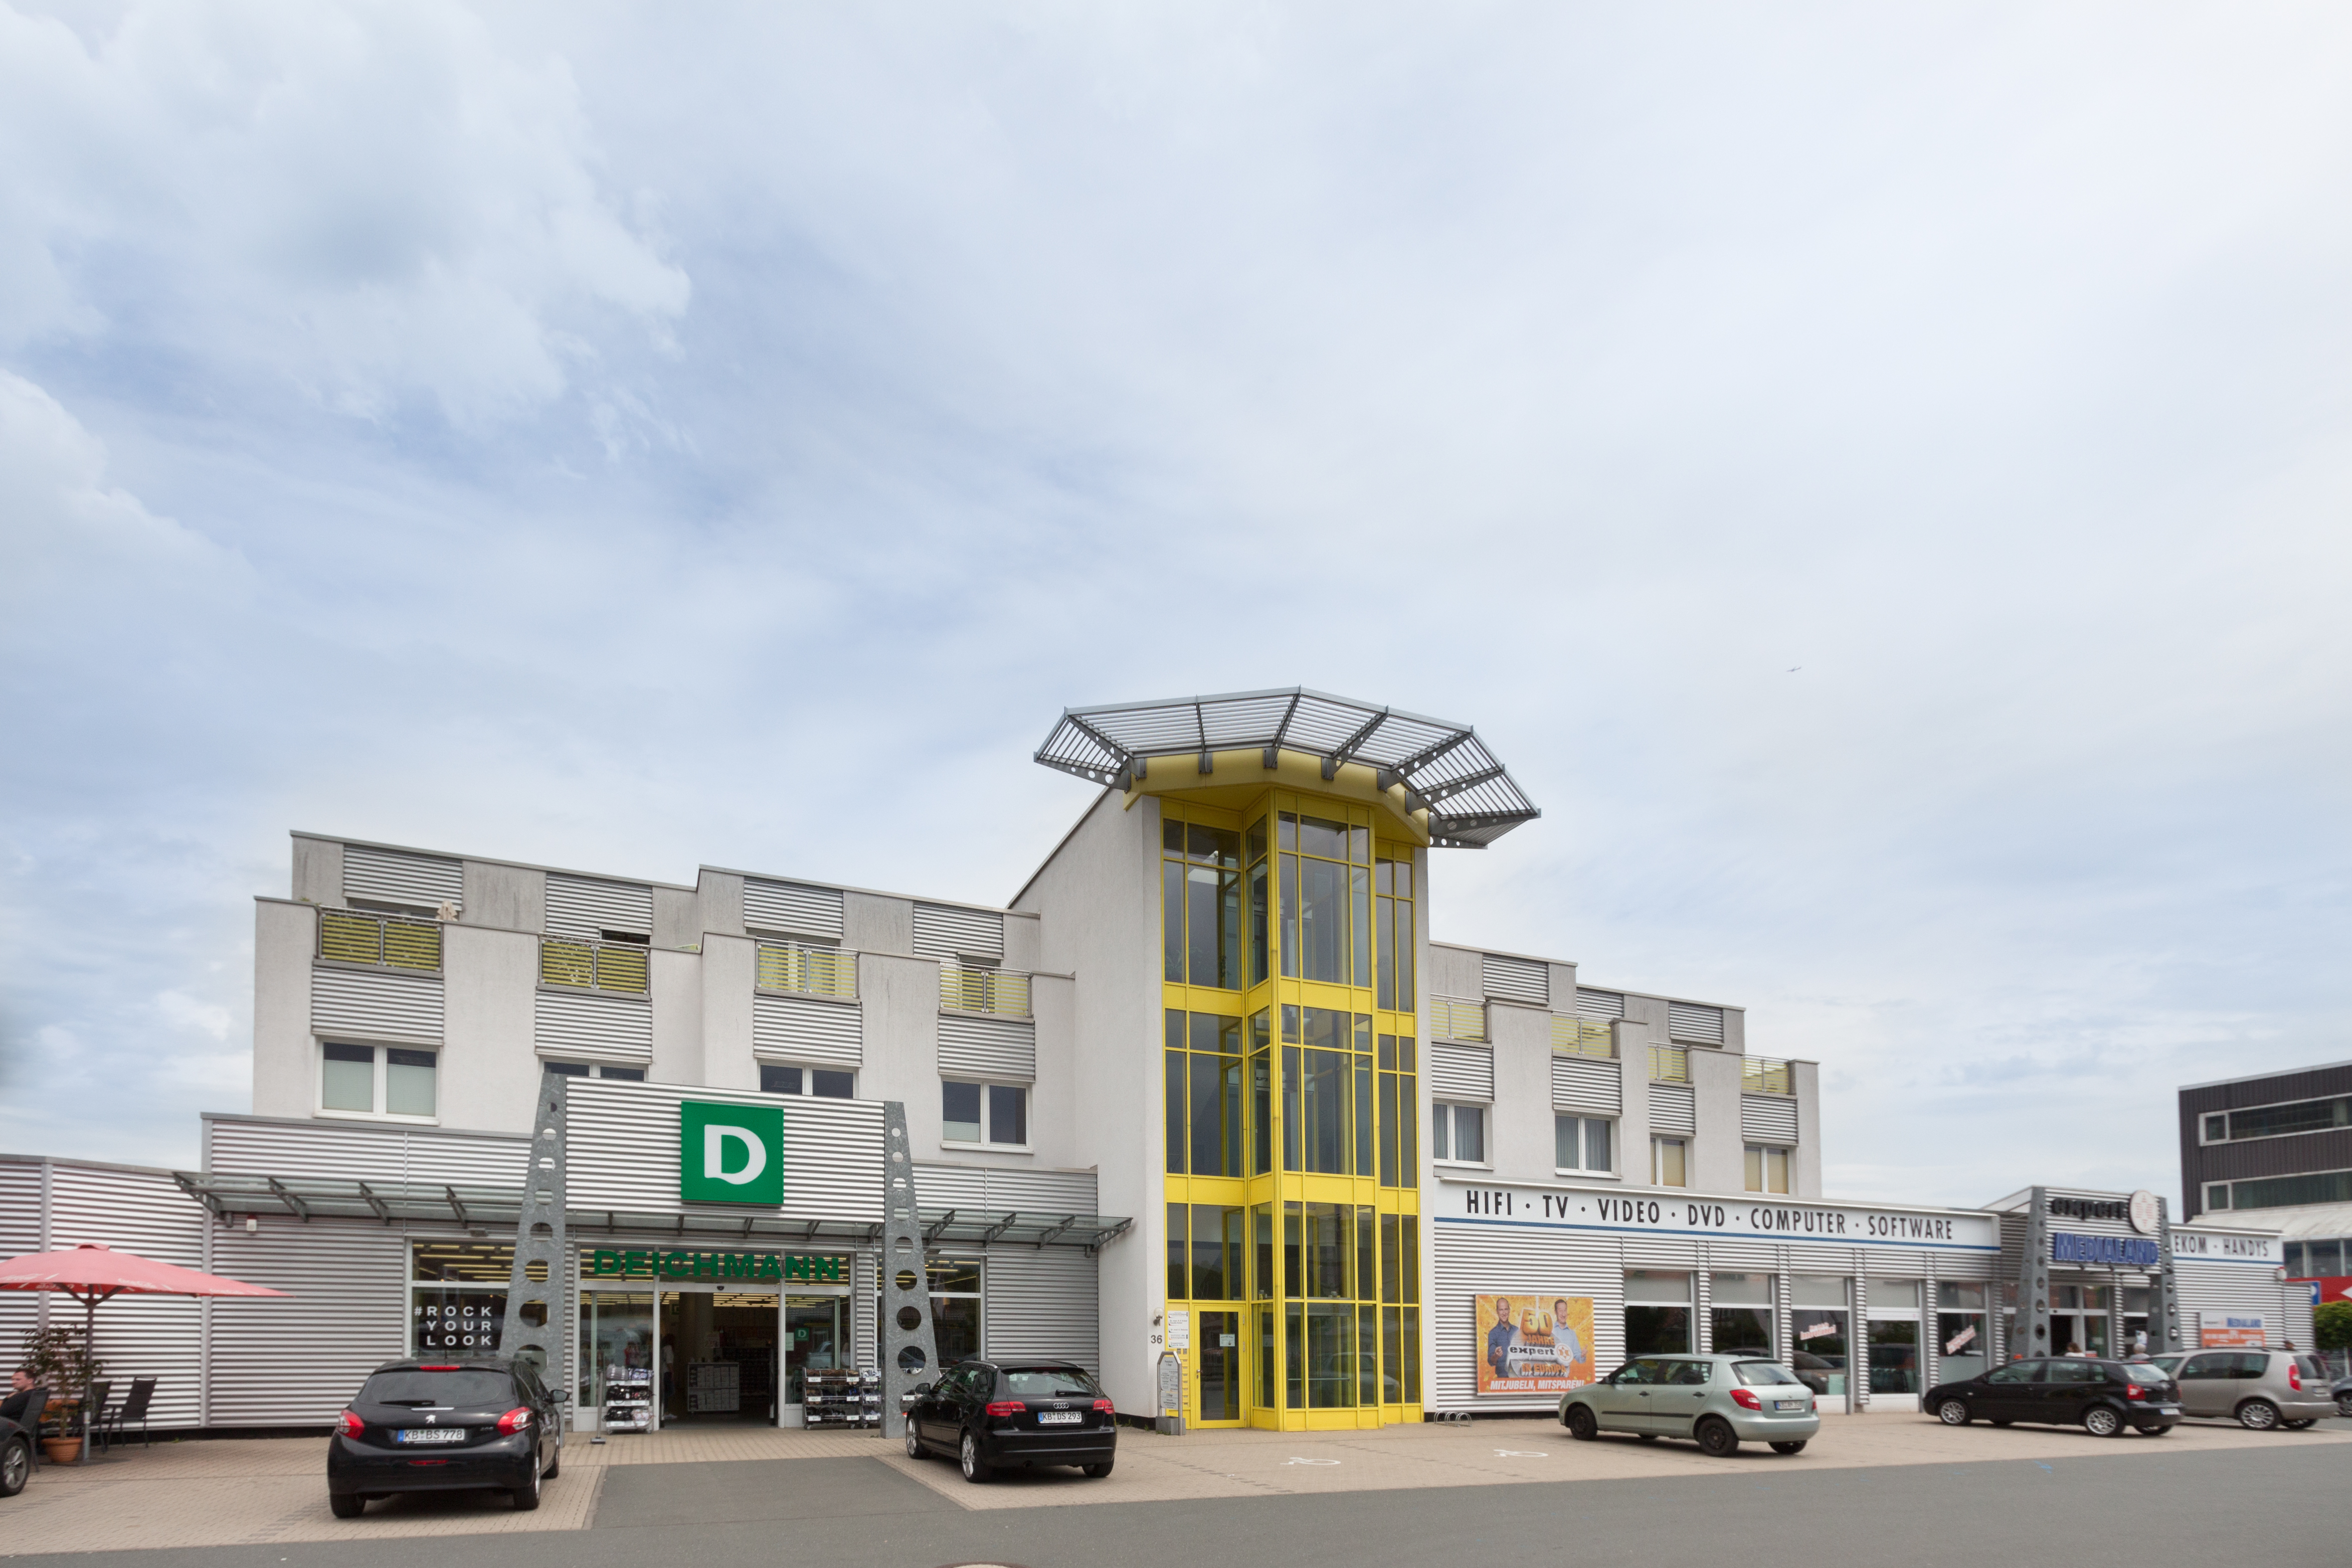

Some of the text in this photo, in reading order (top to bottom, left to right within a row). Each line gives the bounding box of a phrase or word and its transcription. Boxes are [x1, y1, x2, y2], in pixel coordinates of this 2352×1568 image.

[704, 1124, 766, 1185] D
[1466, 1190, 1953, 1240] HIFI TV VIDEO DVD COMPUTER SOFTWARE
[2051, 1198, 2129, 1220] expert
[2054, 1231, 2159, 1265] MEDIALAND
[2172, 1235, 2269, 1257] EKOM HANDYS
[593, 1250, 839, 1280] DEICHMANN
[414, 1305, 492, 1317] #ROCK
[426, 1321, 492, 1331] YOUR
[1520, 1309, 1554, 1337] 50
[426, 1335, 492, 1346] LOOK
[1151, 1335, 1163, 1344] 36
[1526, 1334, 1556, 1347] JAHRE
[1510, 1346, 1555, 1356] expert
[1521, 1363, 1567, 1375] IN EUROPA
[1490, 1380, 1585, 1391] MITJUBELN, MITSPAREN!
[404, 1429, 463, 1439] KB BS 778
